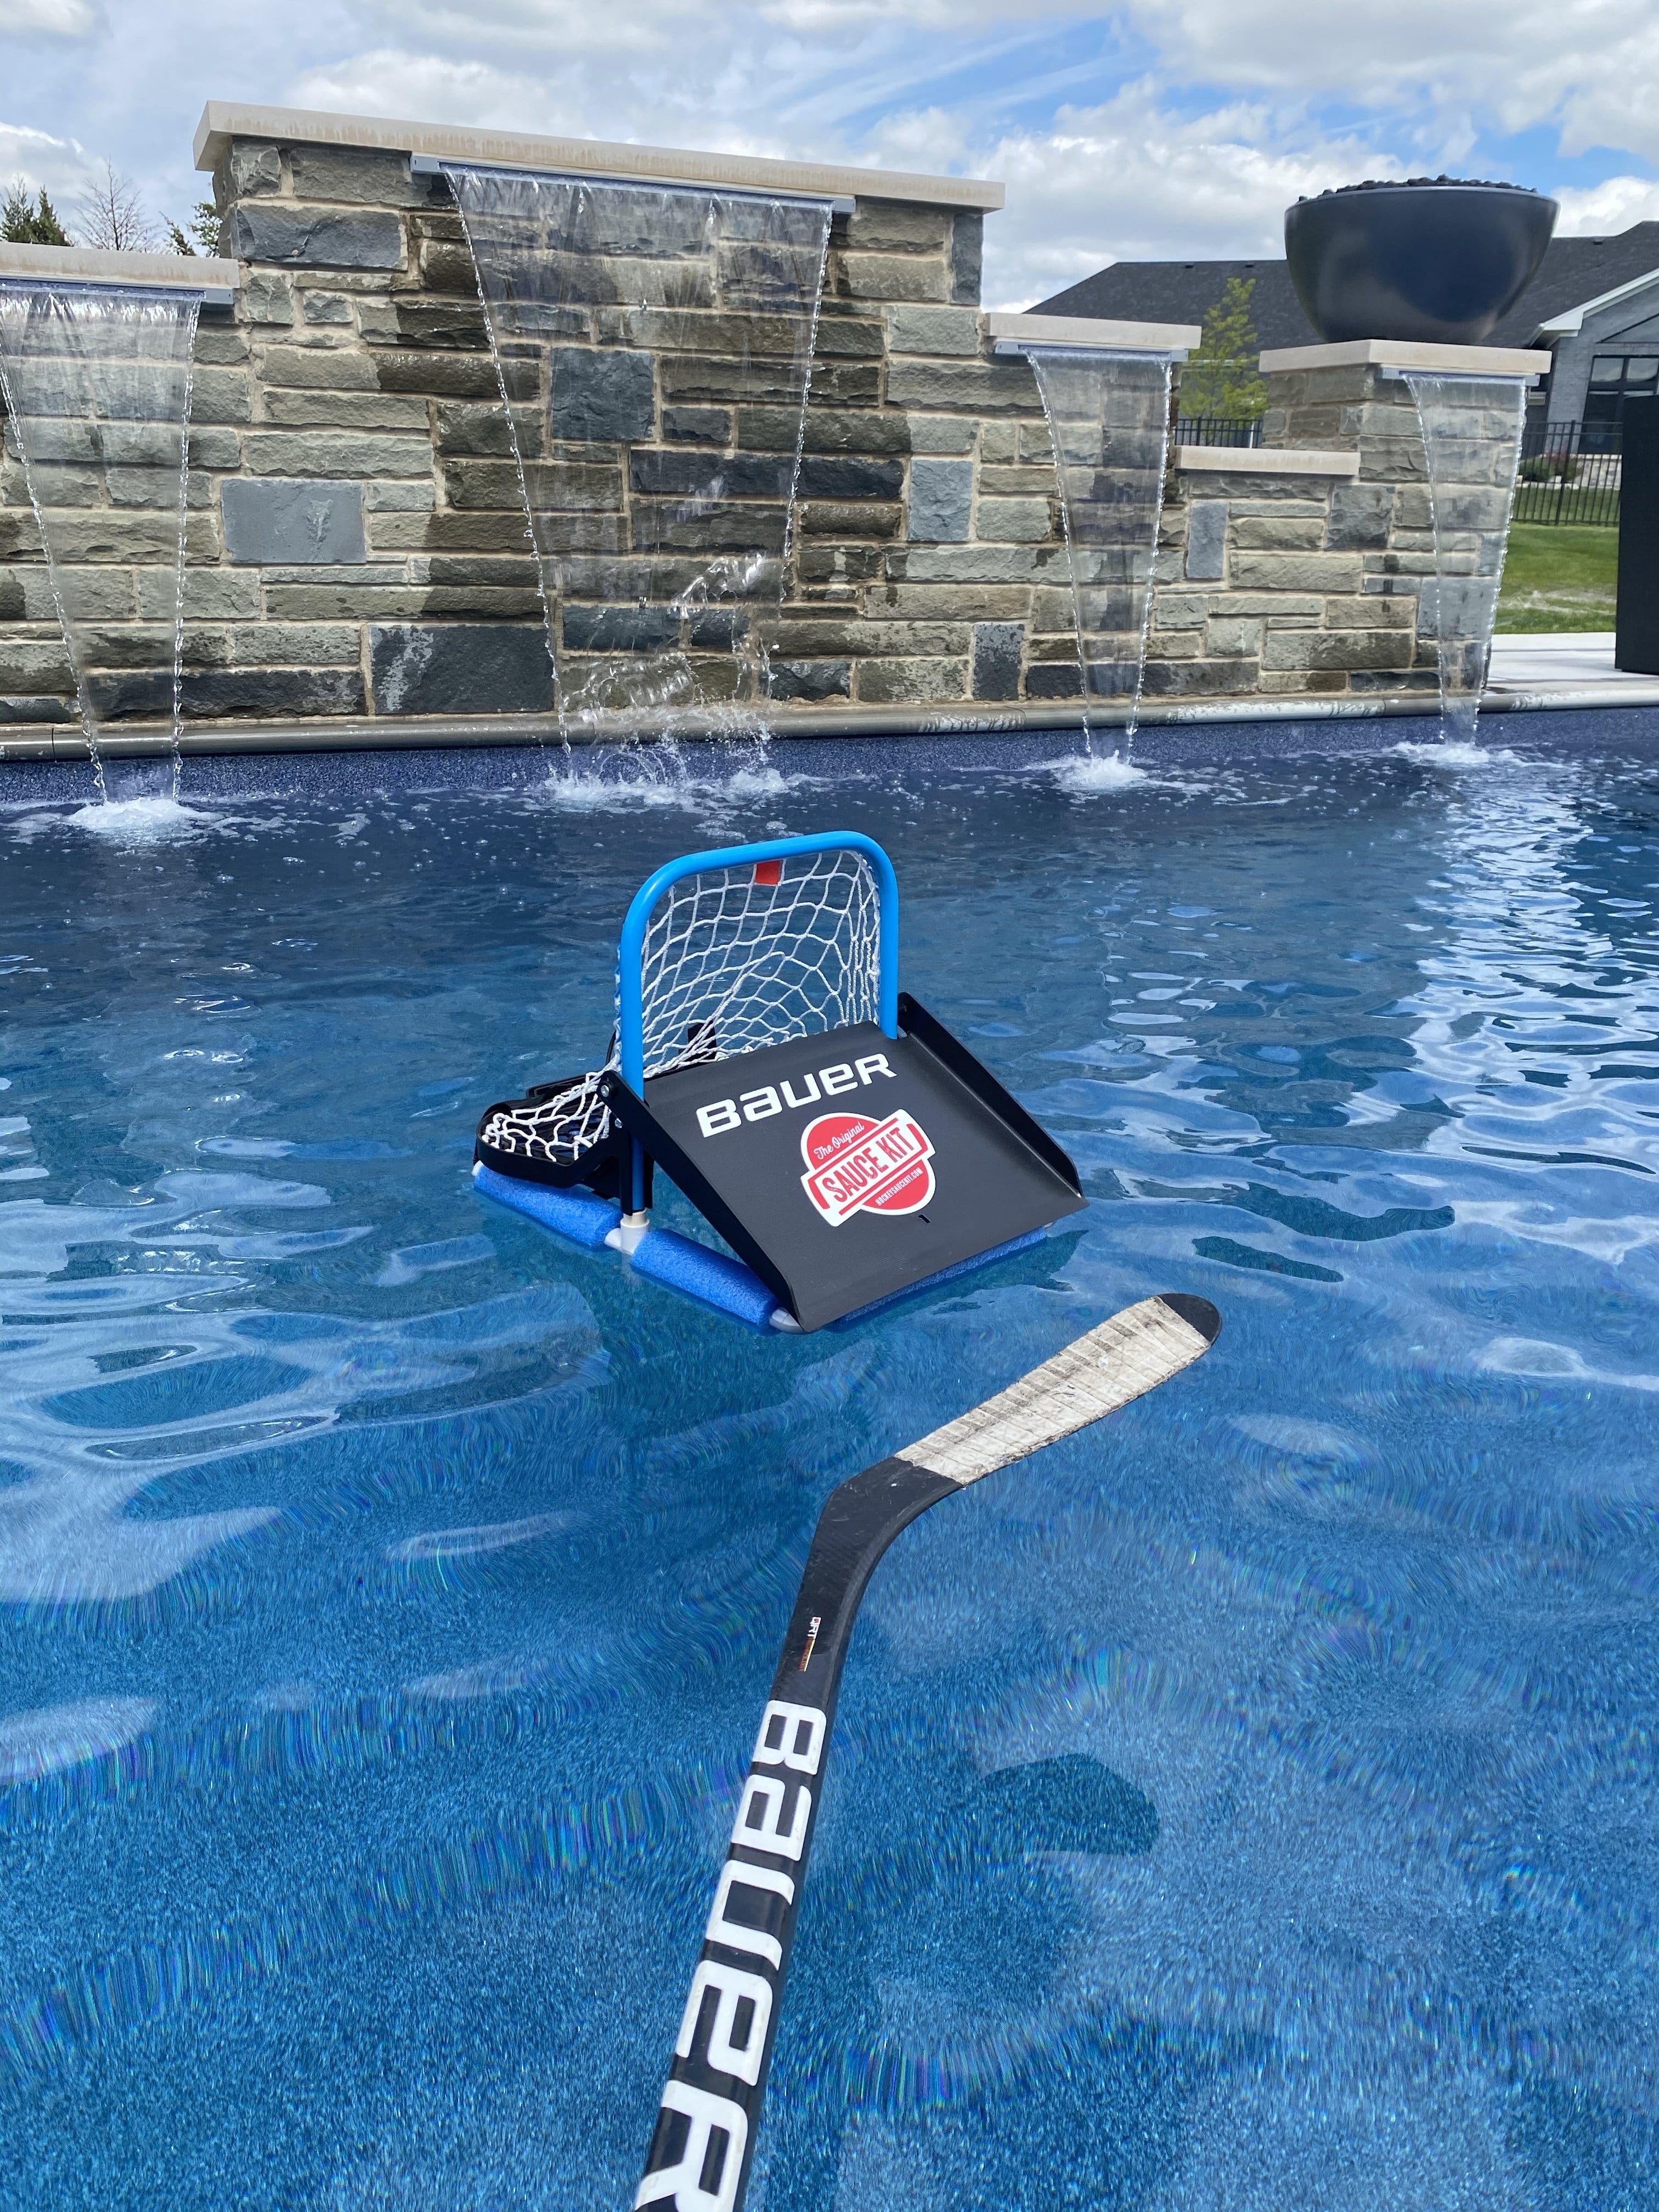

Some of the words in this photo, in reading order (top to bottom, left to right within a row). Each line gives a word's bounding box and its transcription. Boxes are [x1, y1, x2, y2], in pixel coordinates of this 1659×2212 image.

[814, 1146, 834, 1160] The
[832, 1121, 865, 1149] Original
[822, 1147, 889, 1202] SAUCE
[876, 1127, 914, 1163] KIT
[874, 1167, 924, 1206] HOCKEYSAUCEKIT.COM
